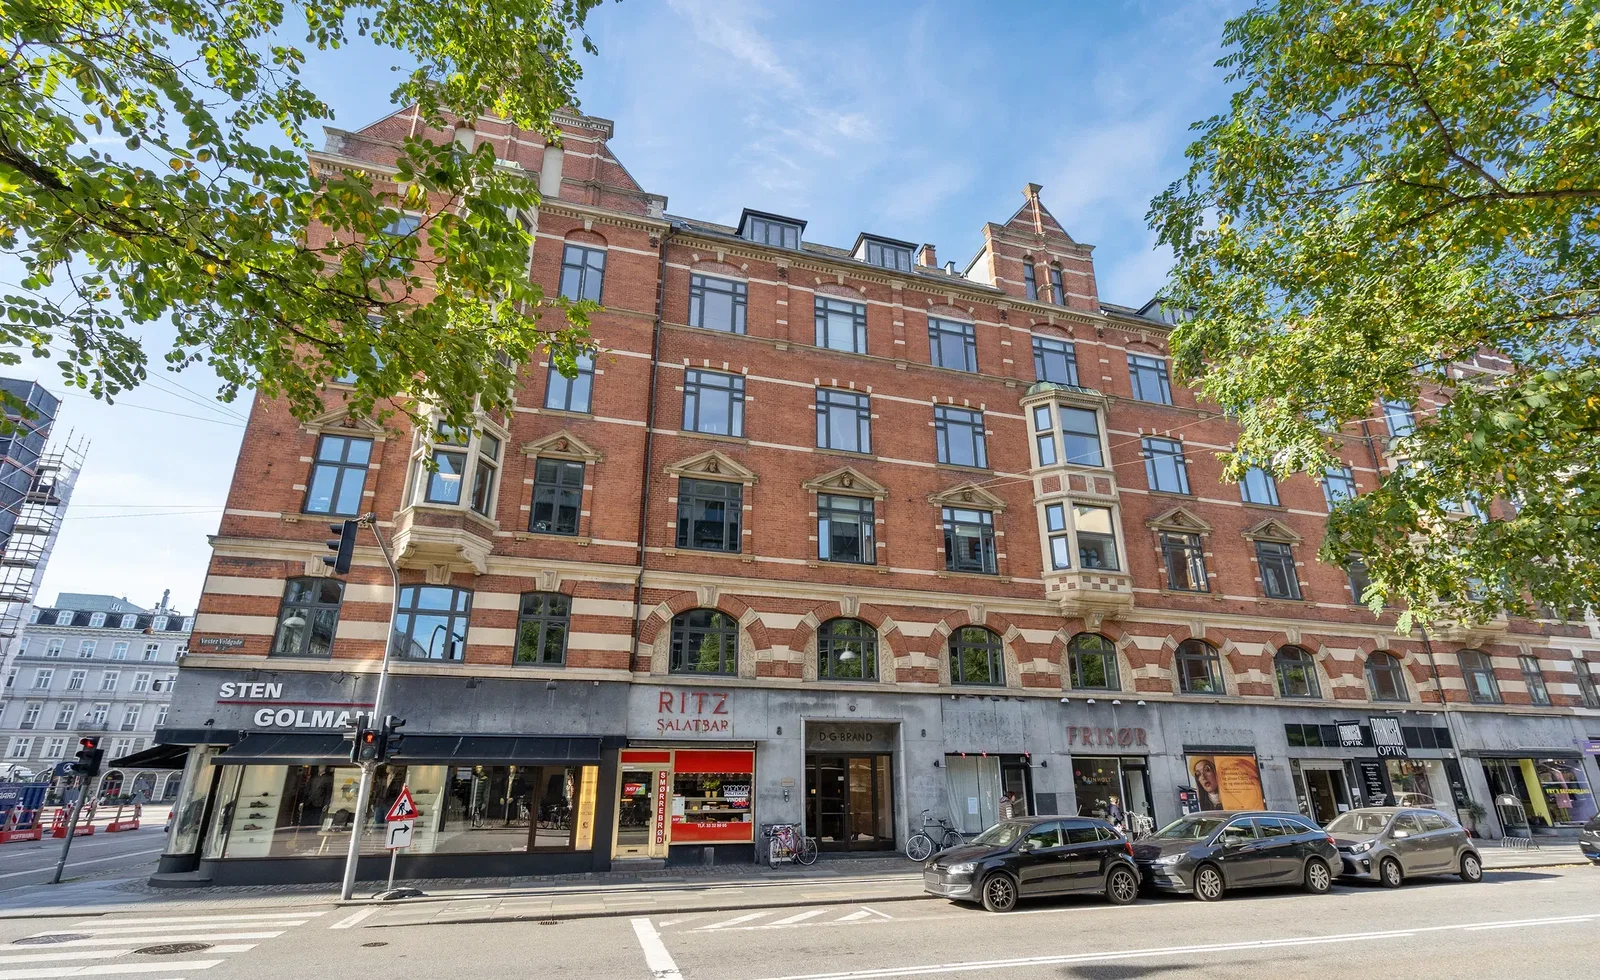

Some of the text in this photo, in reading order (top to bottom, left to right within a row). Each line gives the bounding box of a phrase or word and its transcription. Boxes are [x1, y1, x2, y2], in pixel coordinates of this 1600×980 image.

[219, 682, 283, 698] STEN
[658, 691, 729, 714] RITZ
[253, 708, 391, 728] GOLMAN
[656, 718, 729, 732] SALATBAR
[1066, 725, 1148, 747] FRISØR
[1377, 745, 1407, 756] OPTIK
[656, 772, 666, 843] SMØRREBRØD
